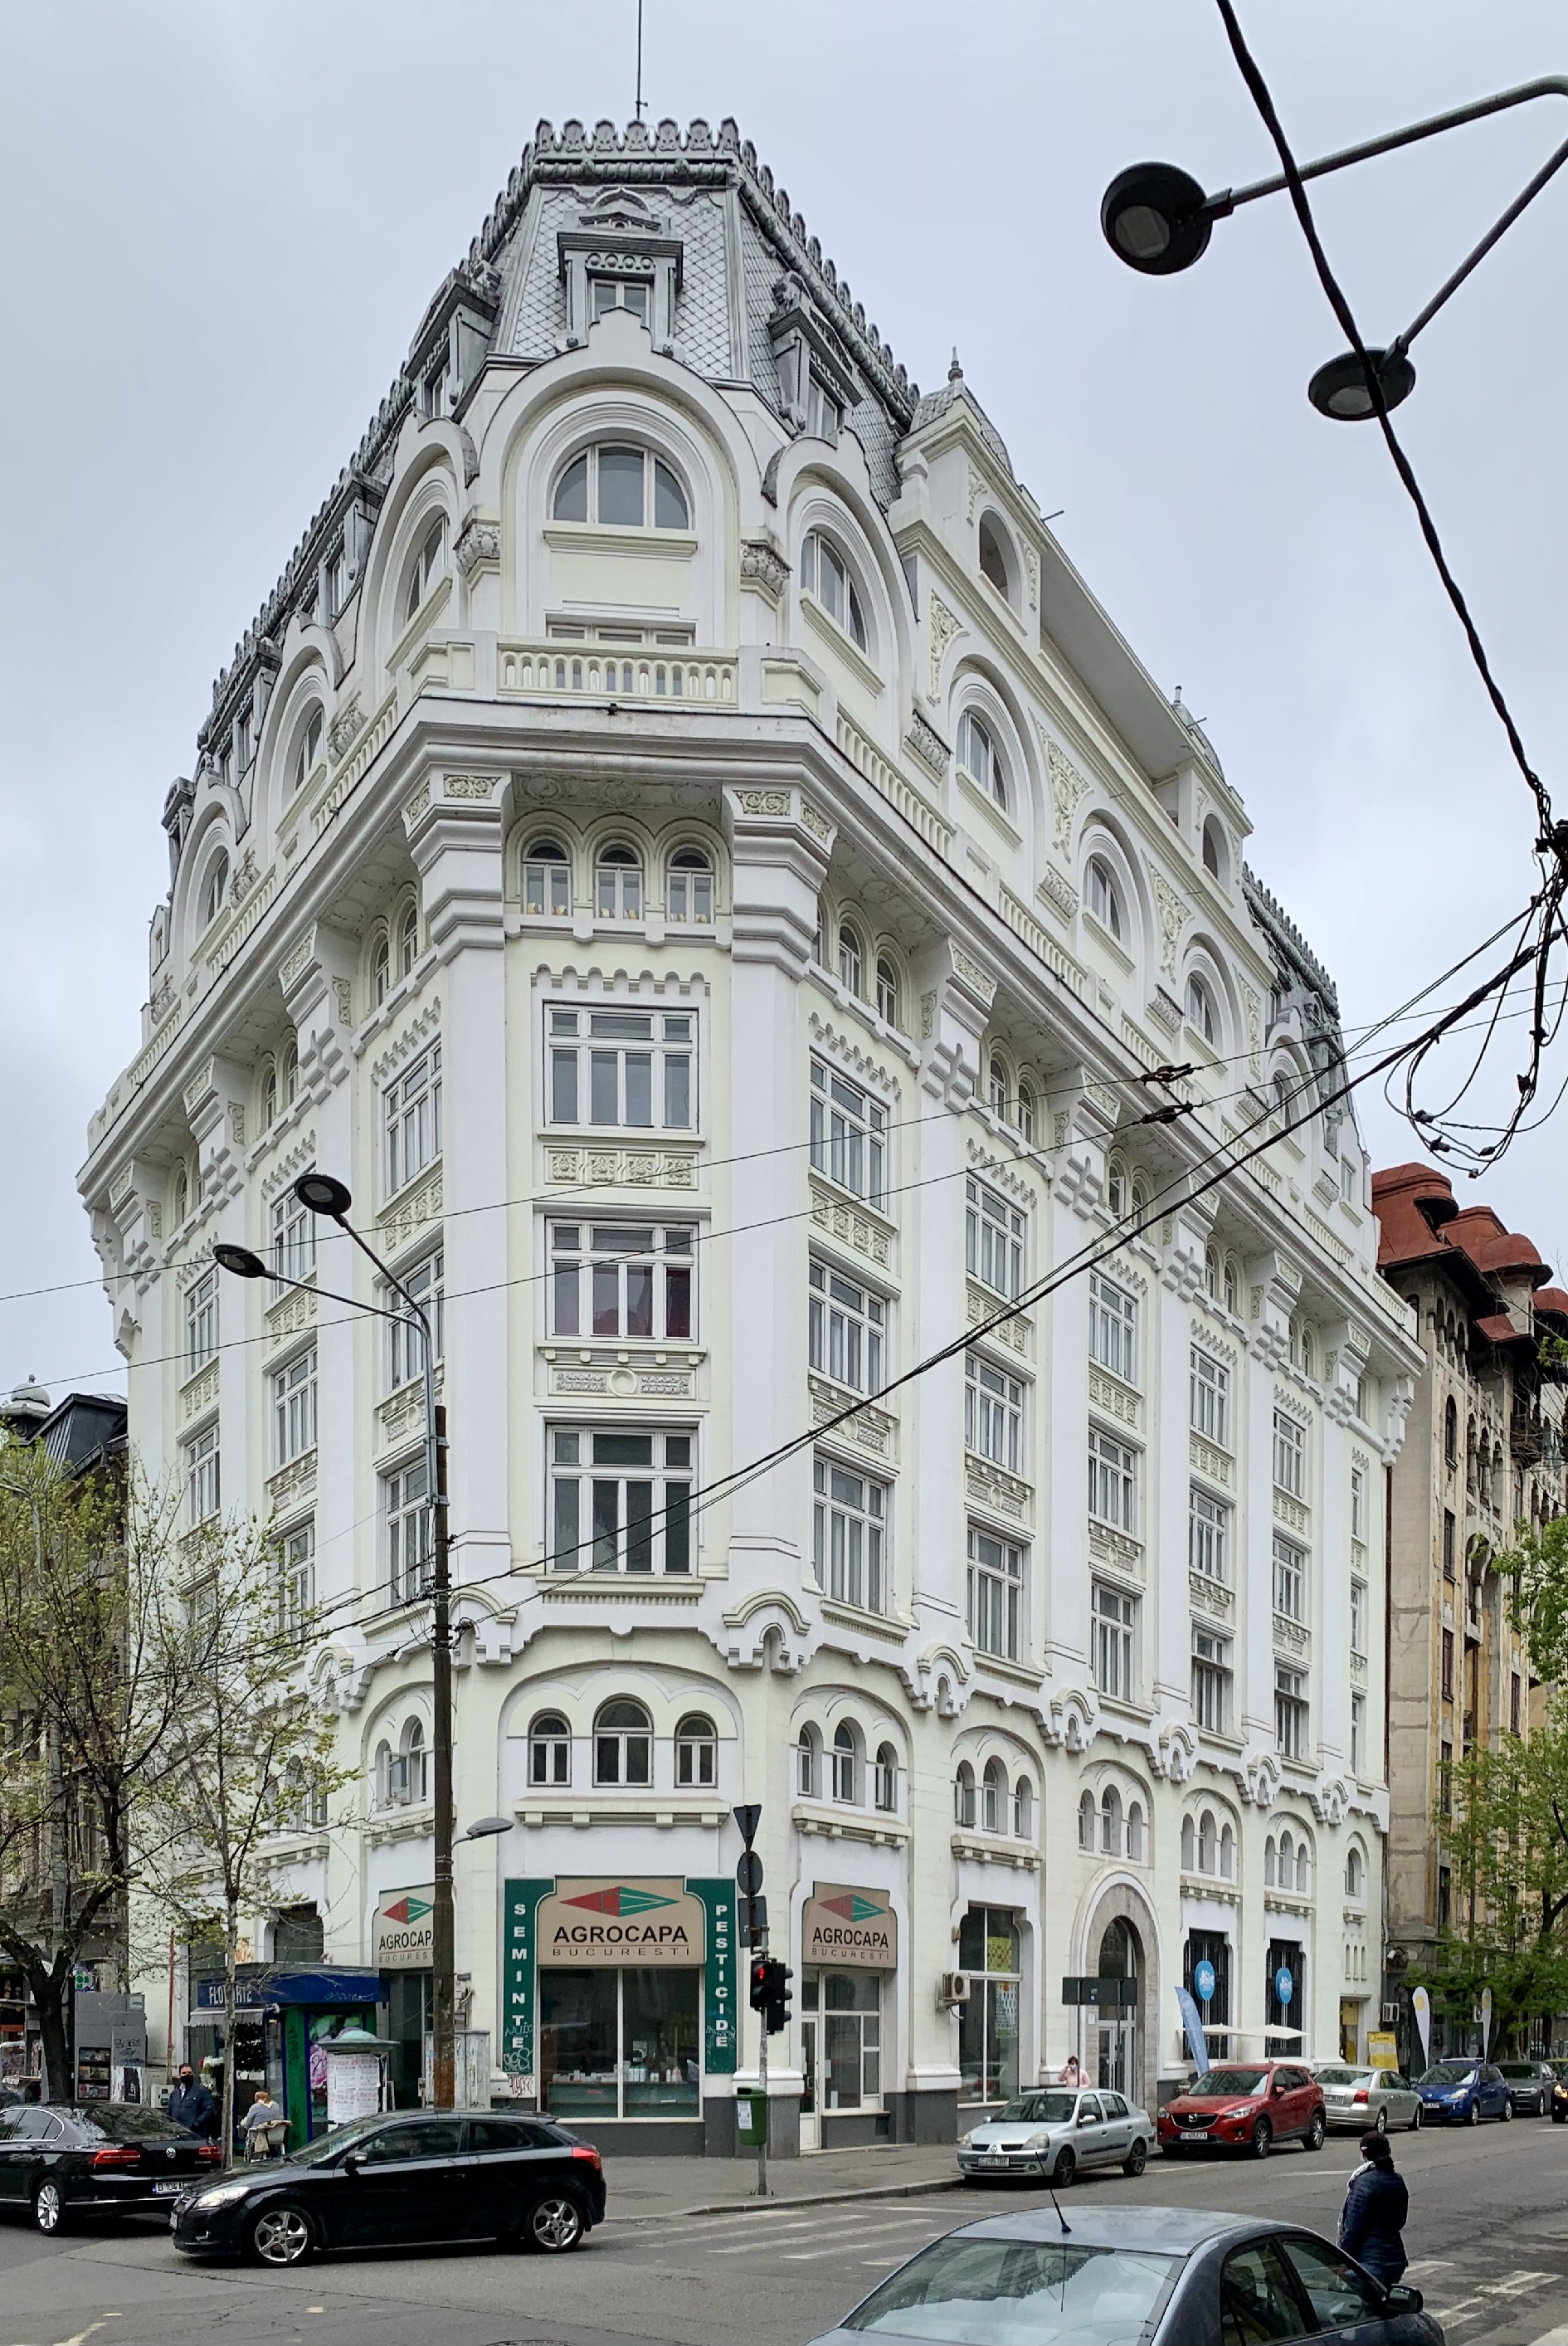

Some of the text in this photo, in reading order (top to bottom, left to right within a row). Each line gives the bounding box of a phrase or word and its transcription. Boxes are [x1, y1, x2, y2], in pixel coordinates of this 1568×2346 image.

[378, 1930, 434, 1951] AGROCAP
[553, 1925, 689, 1944] AGROCAPA
[812, 1926, 889, 1948] AGROCAPA
[378, 1951, 434, 1963] BUCURES
[553, 1947, 689, 1957] BUCURESTI
[811, 1947, 890, 1961] BUCURESTI
[511, 1903, 528, 2049] SEMINTE
[714, 1904, 729, 2047] PESTICIDE
